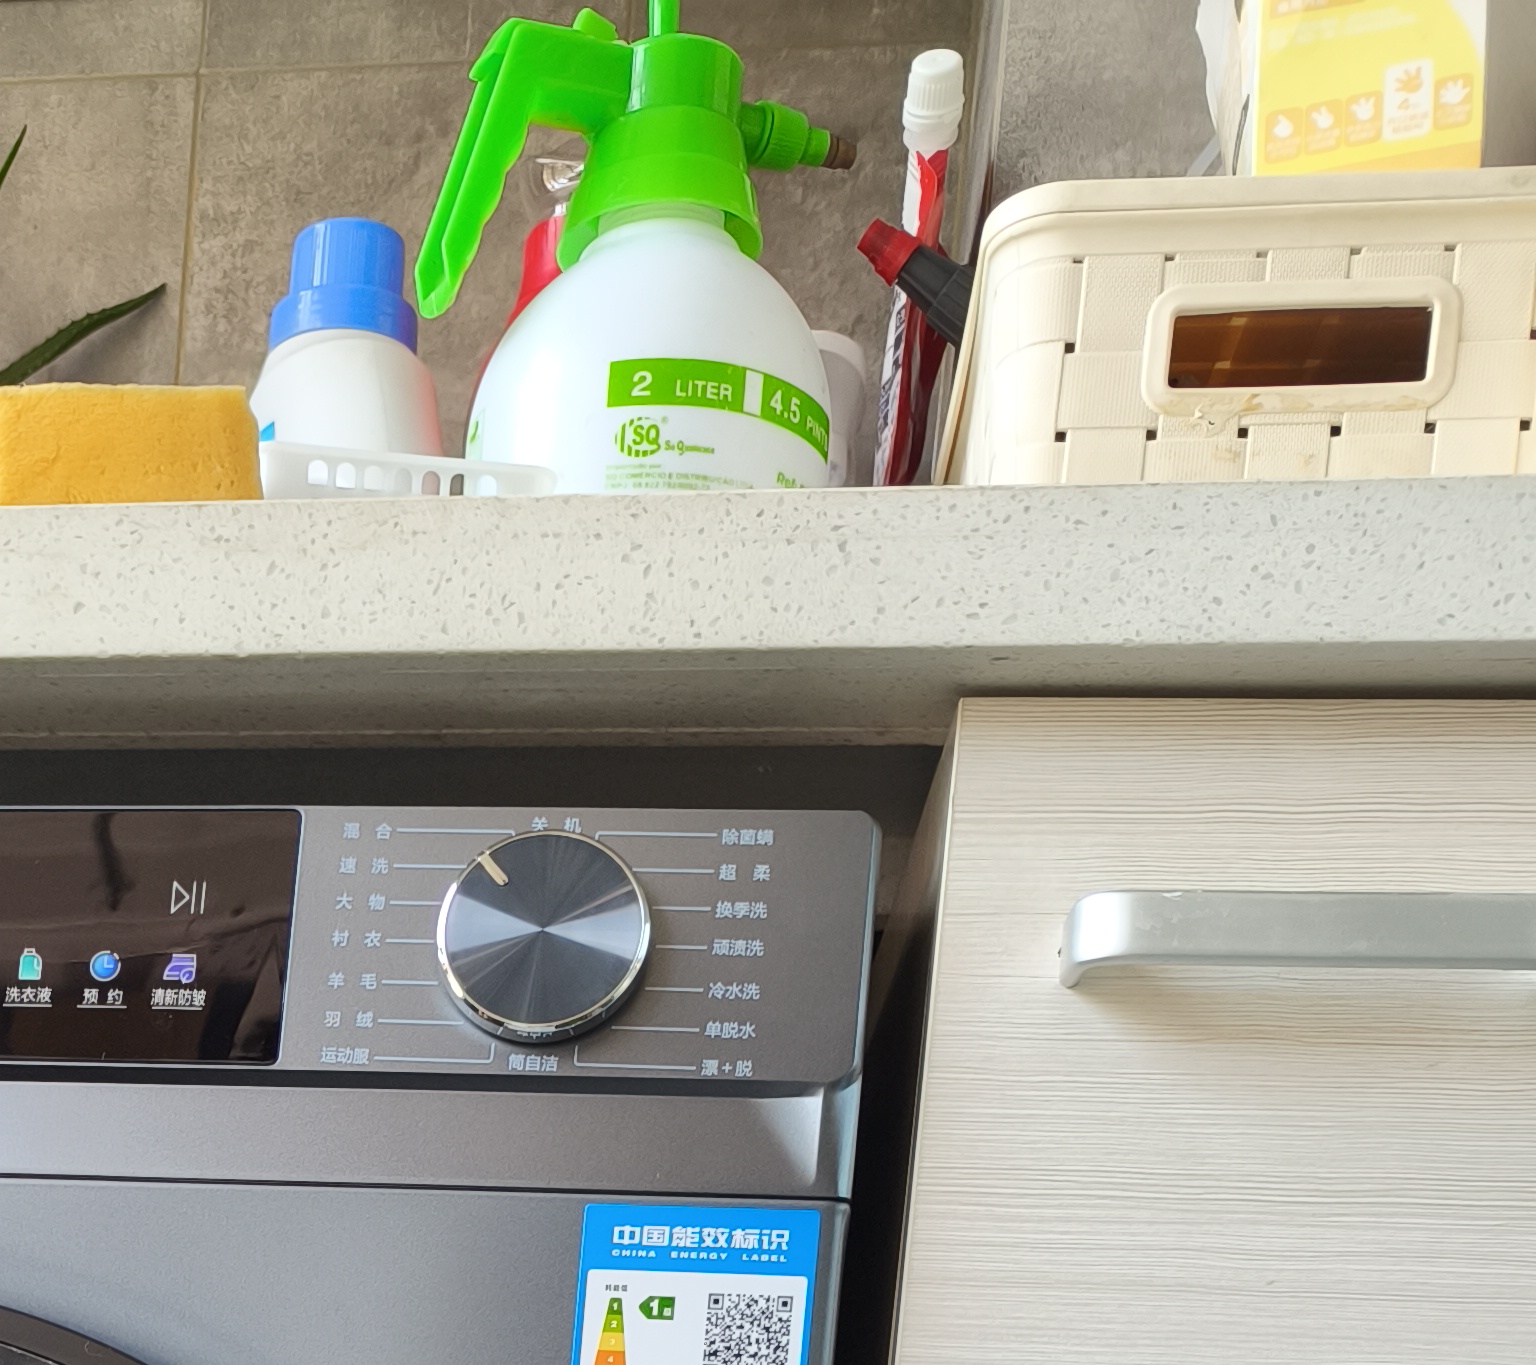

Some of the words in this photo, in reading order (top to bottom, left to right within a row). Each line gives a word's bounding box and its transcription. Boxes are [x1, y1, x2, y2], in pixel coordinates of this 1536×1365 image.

[631, 371, 653, 397] 2
[675, 379, 733, 402] LITER
[769, 389, 801, 424] 4.5
[632, 424, 661, 446] SQ
[342, 822, 393, 840] 混合
[531, 817, 582, 833] 关机
[721, 828, 775, 846] 除菌螨
[339, 857, 389, 875] 速洗
[718, 863, 771, 881] 超柔
[335, 892, 386, 911] 大物
[715, 900, 768, 919] 换季洗
[331, 930, 382, 948] 衬衣
[711, 938, 765, 957] 顽渍洗
[327, 972, 378, 990] 羊毛
[4, 986, 53, 1003] 洗衣液
[82, 987, 124, 1005] 预约
[150, 988, 207, 1007] 清新防皱
[708, 982, 761, 1000] 冷水洗
[324, 1011, 374, 1029] 羽绒
[704, 1020, 756, 1039] 单脱水
[320, 1047, 370, 1065] 运动服
[508, 1053, 560, 1073] 筒自洁
[612, 1225, 790, 1251] 中国能效标识
[611, 1248, 657, 1259] CHINA
[669, 1250, 729, 1261] ENERGY
[741, 1253, 788, 1263] LABEL
